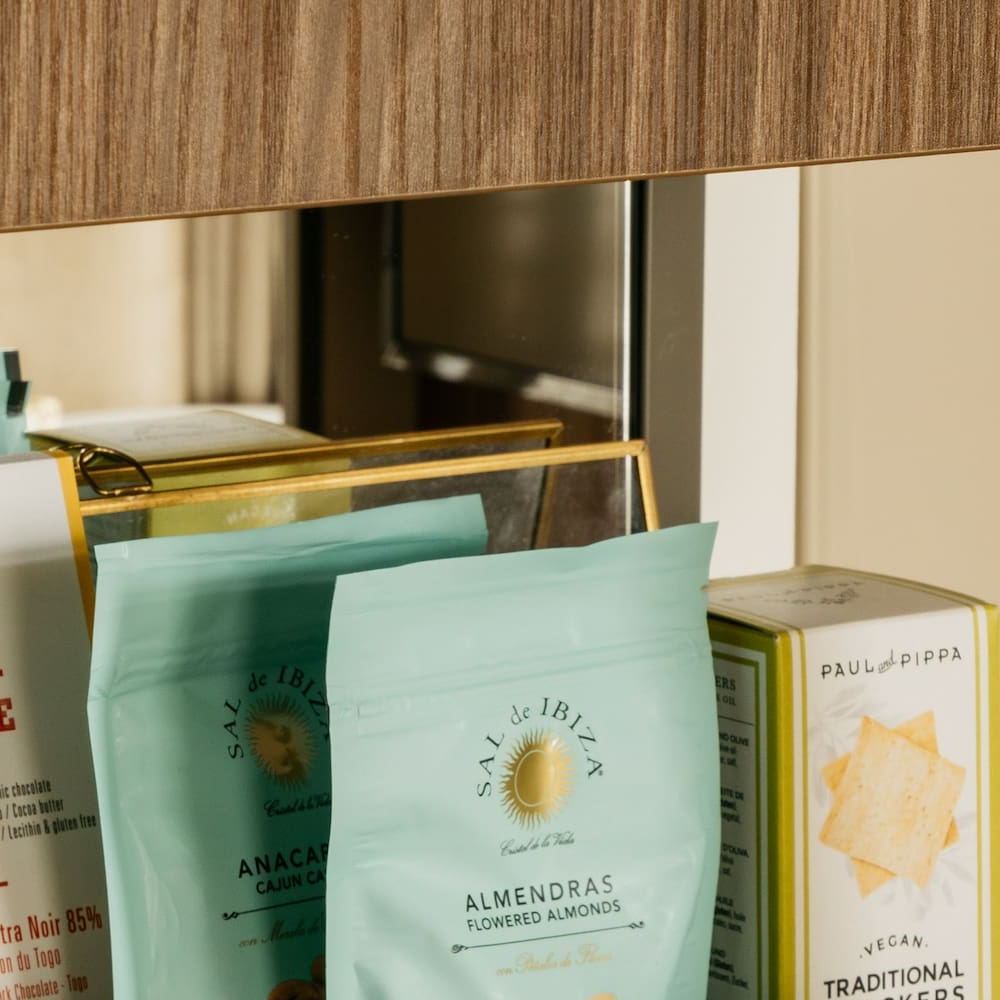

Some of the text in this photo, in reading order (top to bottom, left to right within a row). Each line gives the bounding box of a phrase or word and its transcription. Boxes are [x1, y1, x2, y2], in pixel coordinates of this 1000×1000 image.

[821, 647, 962, 679] PAUL and PIPPA
[224, 698, 244, 759] SAL
[248, 673, 267, 692] de
[477, 697, 603, 797] SAL de IBIZA
[11, 779, 52, 798] chocolate
[12, 802, 37, 819] Cocoa
[7, 821, 42, 841] Lecithin
[52, 815, 78, 836] gluten
[80, 813, 97, 830] free
[256, 874, 302, 894] CAJUN
[465, 874, 614, 913] ALMENDRAS
[27, 914, 61, 941] Noir
[66, 904, 103, 934] 85%
[467, 899, 621, 932] FLOWERED ALMONDS
[17, 950, 31, 972] du
[34, 946, 62, 971] Togo
[67, 974, 88, 994] Togo
[824, 959, 964, 999] TRADITIONAL
